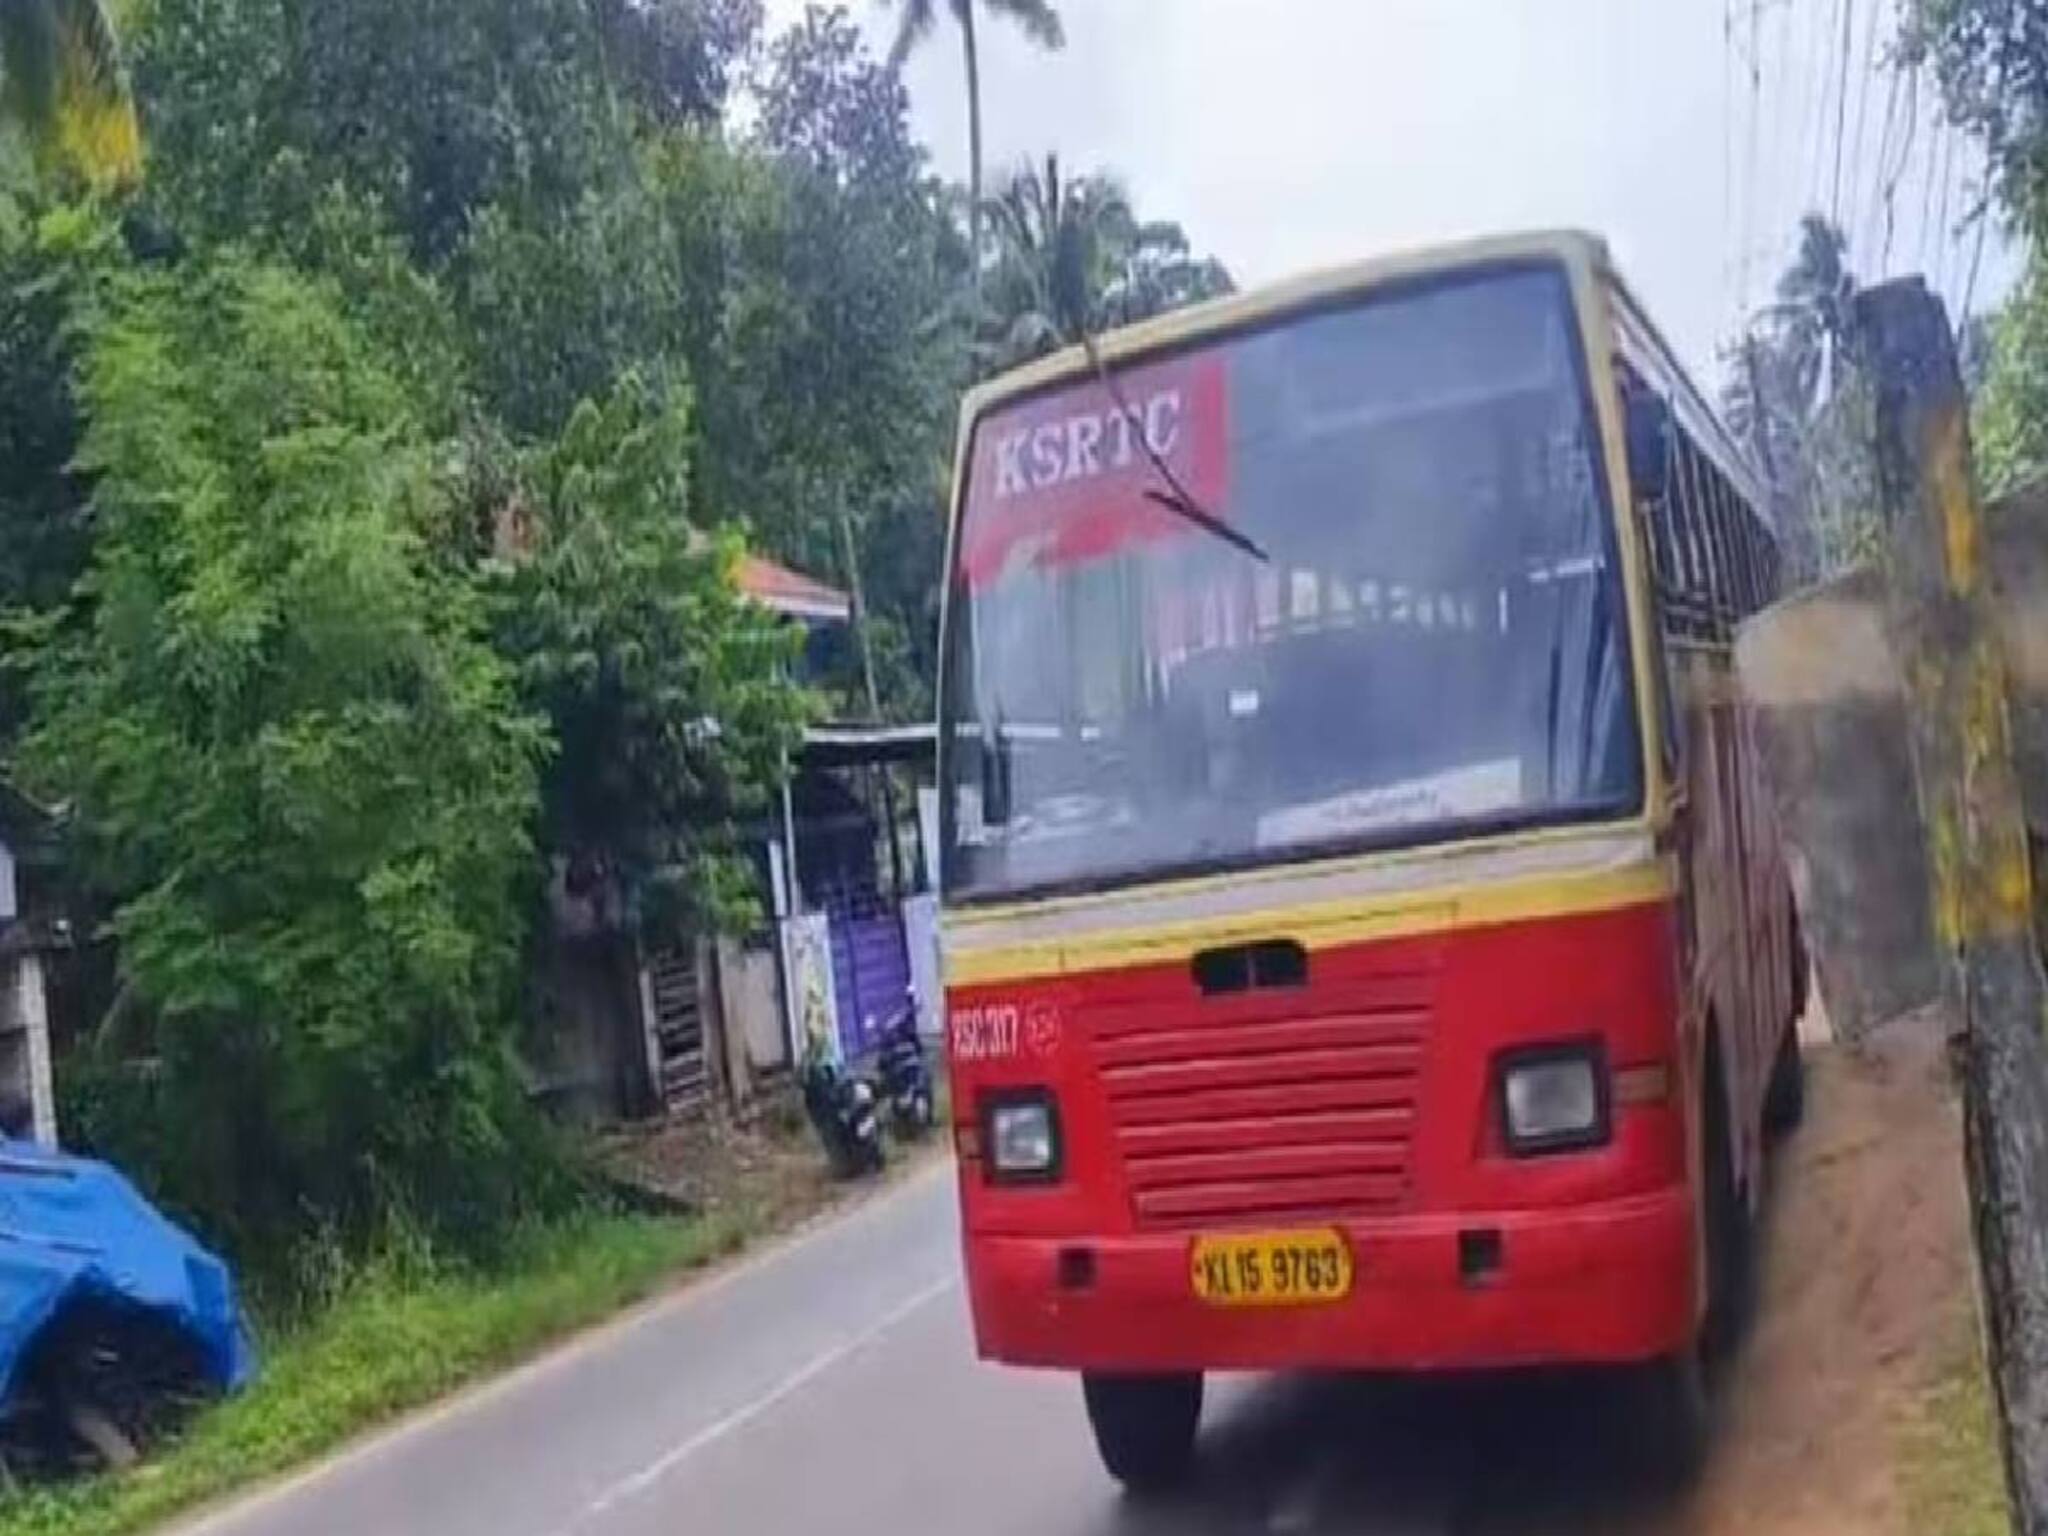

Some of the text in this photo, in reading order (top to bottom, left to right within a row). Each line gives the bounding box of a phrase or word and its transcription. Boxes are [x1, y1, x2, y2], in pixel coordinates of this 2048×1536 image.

[996, 391, 1180, 495] KSRTC
[1236, 1248, 1261, 1293] 15
[1271, 1246, 1340, 1293] 9763
